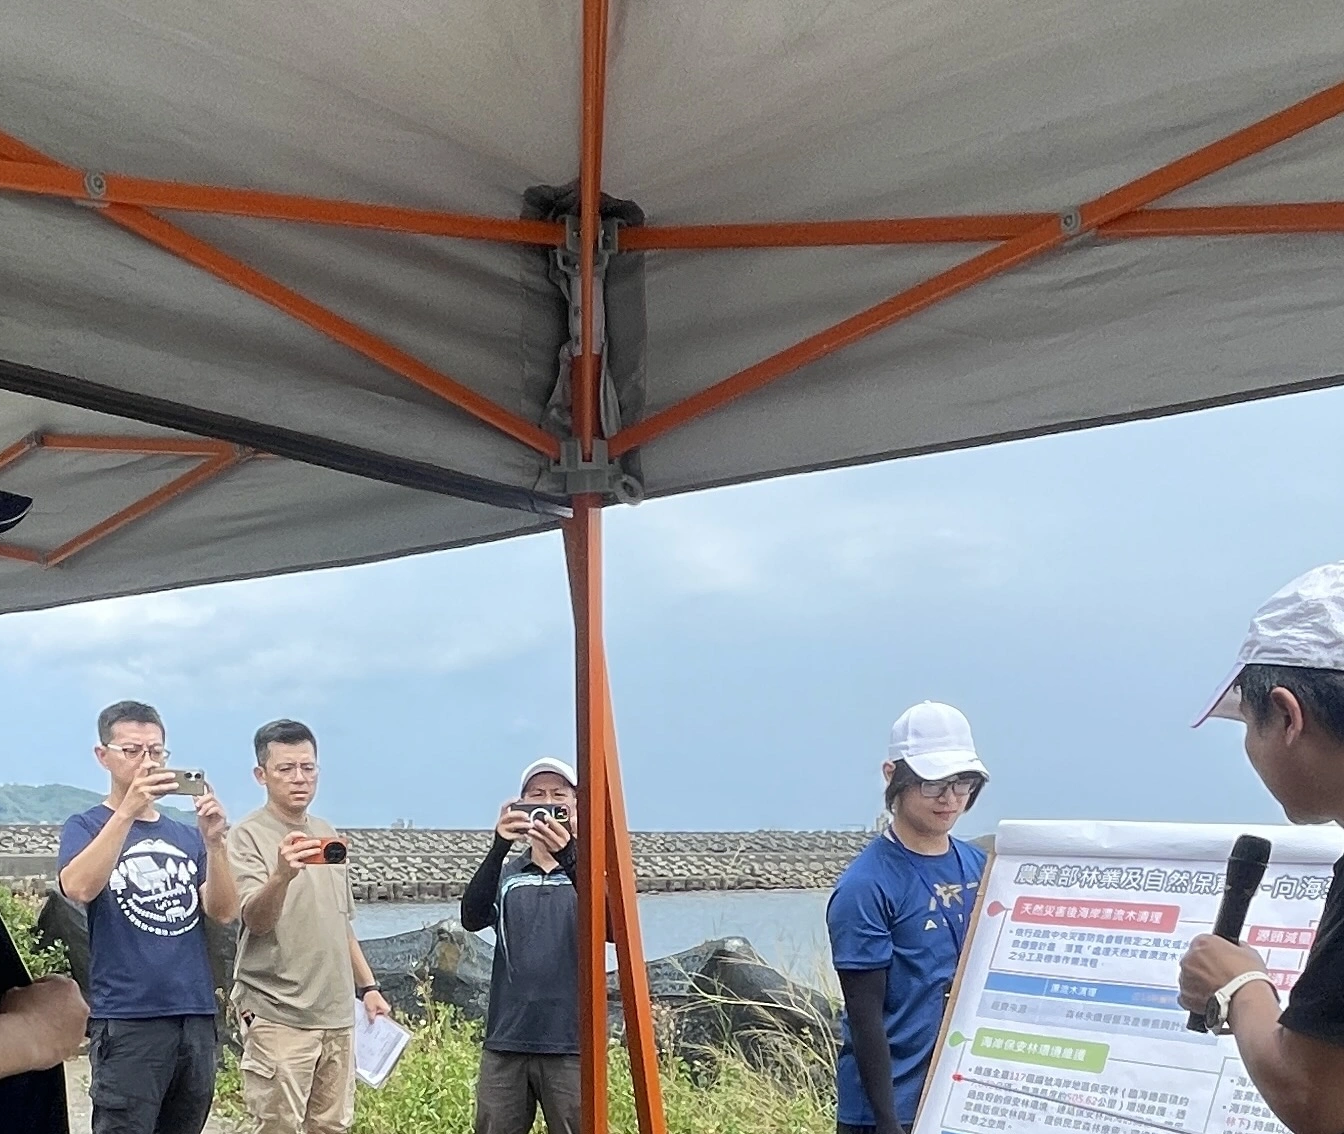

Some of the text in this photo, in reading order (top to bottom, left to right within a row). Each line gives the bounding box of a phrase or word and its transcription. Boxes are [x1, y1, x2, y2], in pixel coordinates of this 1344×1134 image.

[979, 1035, 1087, 1061] 海岸保安林環境維護
